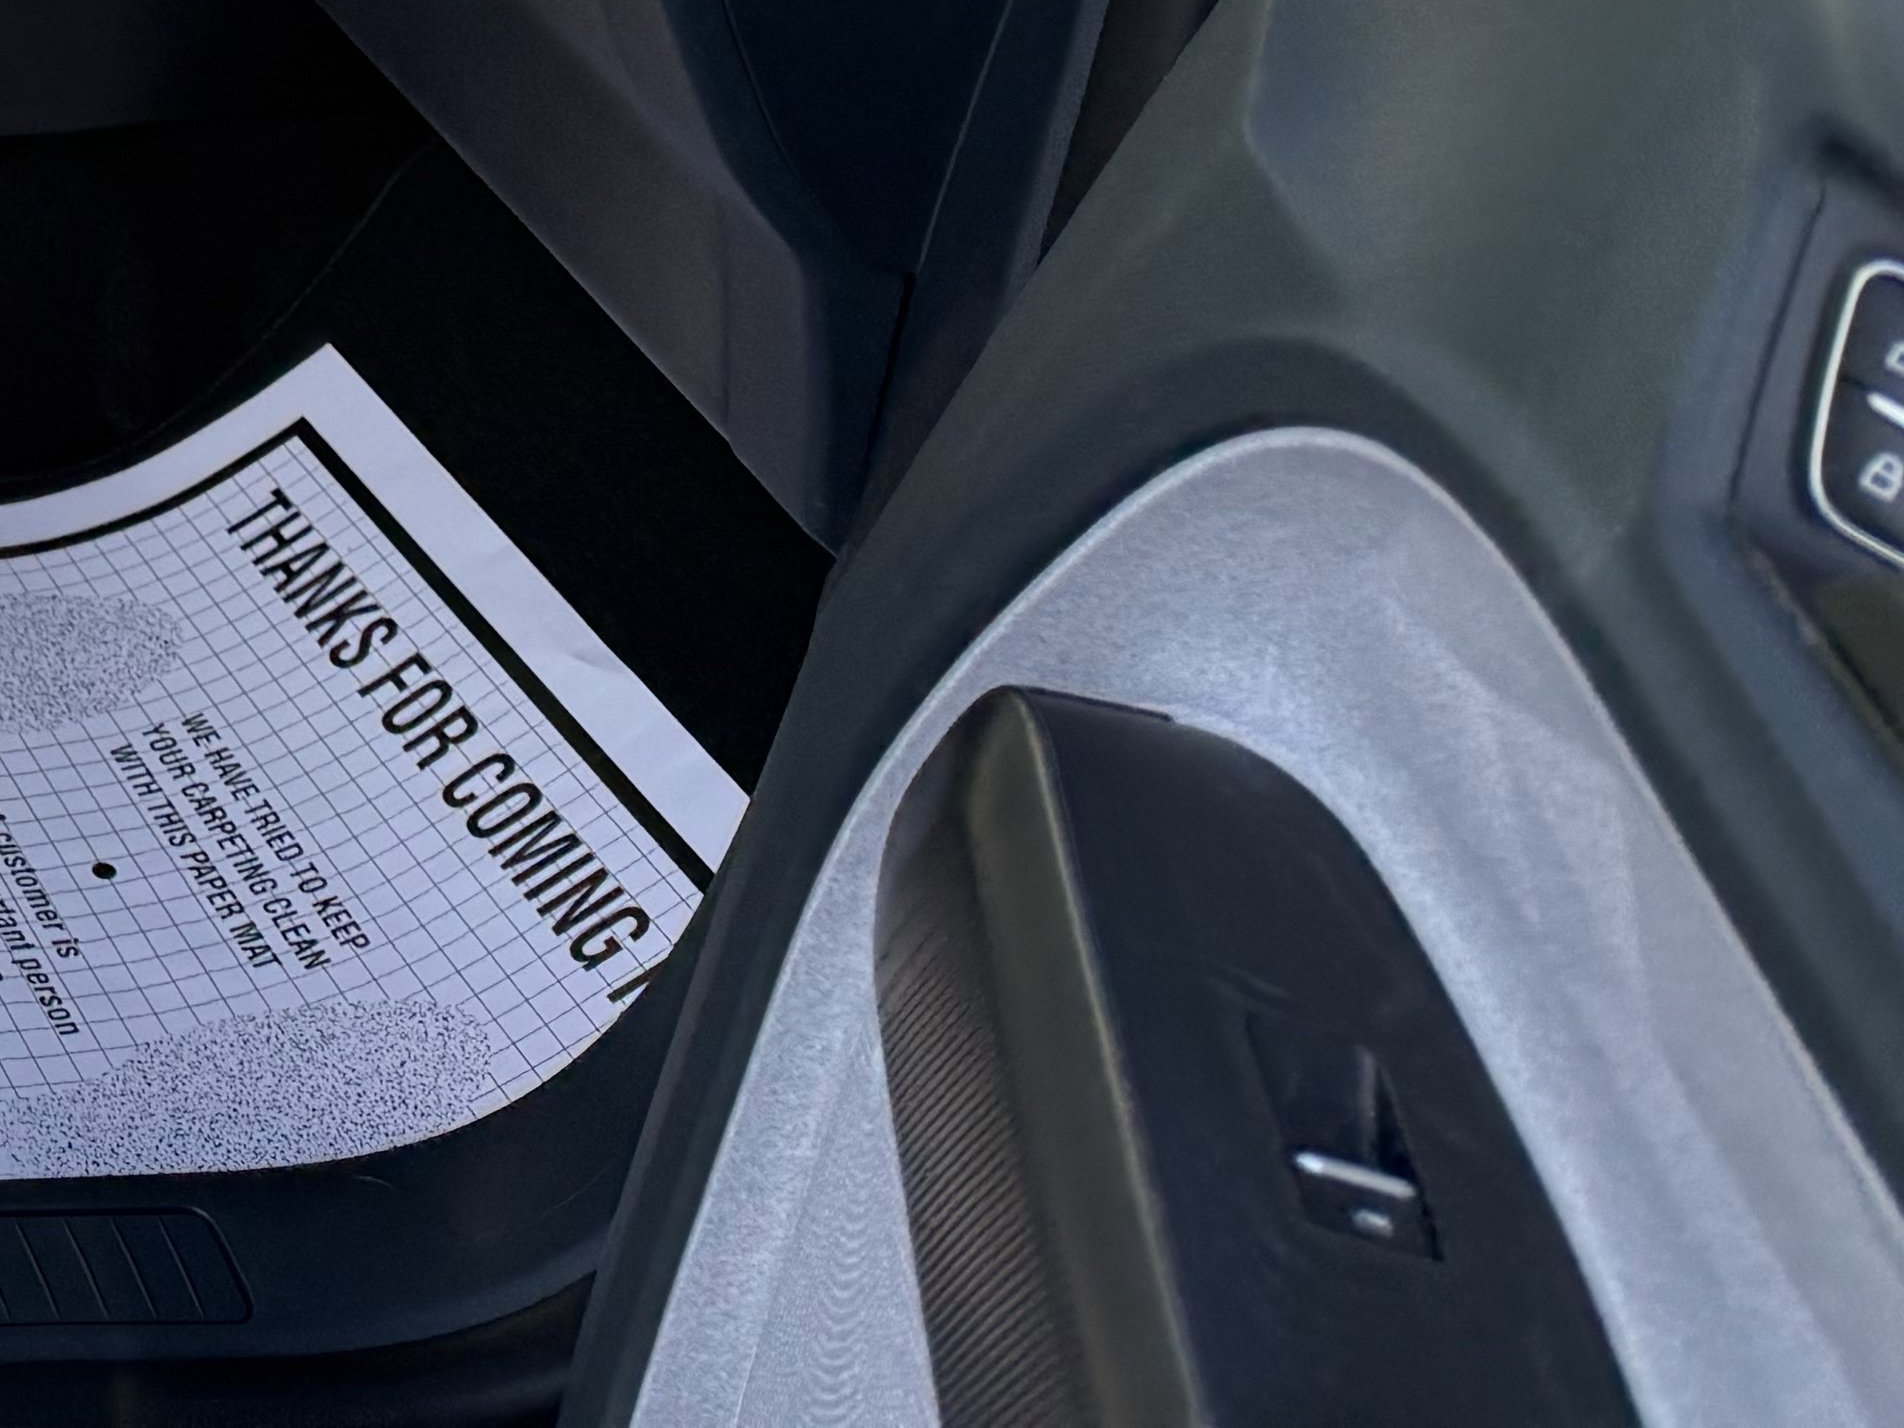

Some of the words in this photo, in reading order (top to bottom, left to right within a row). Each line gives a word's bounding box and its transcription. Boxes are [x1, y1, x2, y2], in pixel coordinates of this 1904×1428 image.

[181, 713, 221, 747] WE
[205, 747, 260, 801] HAVE
[244, 799, 304, 862] TRIED
[290, 862, 328, 894] TO
[312, 895, 371, 950] KEEP
[226, 488, 398, 669] THANKS
[357, 652, 479, 771] FOR
[441, 753, 651, 972] COMING
[51, 937, 80, 959] is
[111, 744, 163, 797] WITH
[147, 794, 196, 847] THIS
[180, 849, 245, 920] PAPER
[230, 921, 282, 968] MAT
[142, 722, 196, 781] YOUR
[181, 782, 278, 895] CARPETING
[263, 898, 331, 970] CLEAN
[12, 957, 80, 1035] person
